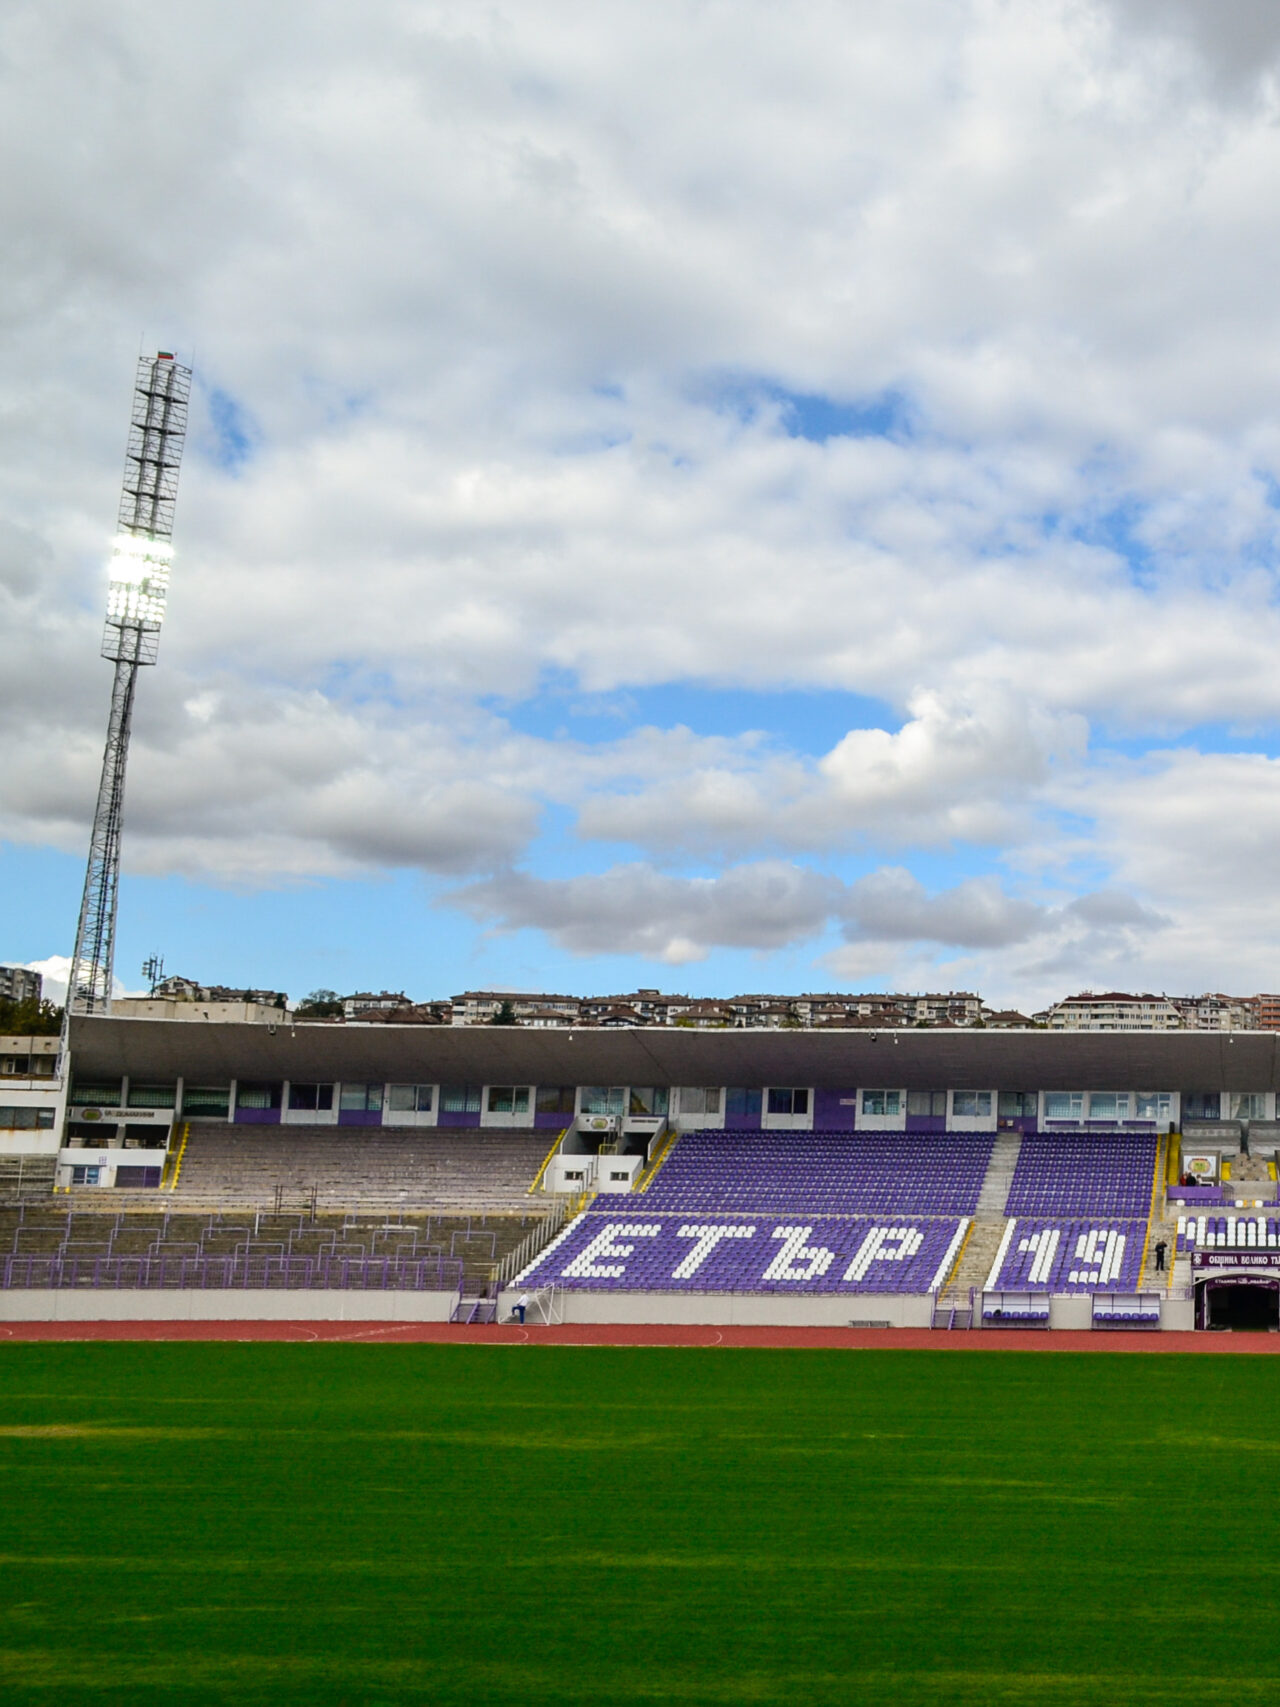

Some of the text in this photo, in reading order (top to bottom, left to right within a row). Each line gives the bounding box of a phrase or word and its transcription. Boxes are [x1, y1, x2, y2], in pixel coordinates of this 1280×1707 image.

[561, 1224, 923, 1281] ЕТЪР
[1018, 1230, 1125, 1284] 19
[1208, 1255, 1239, 1266] ОБЩИНА
